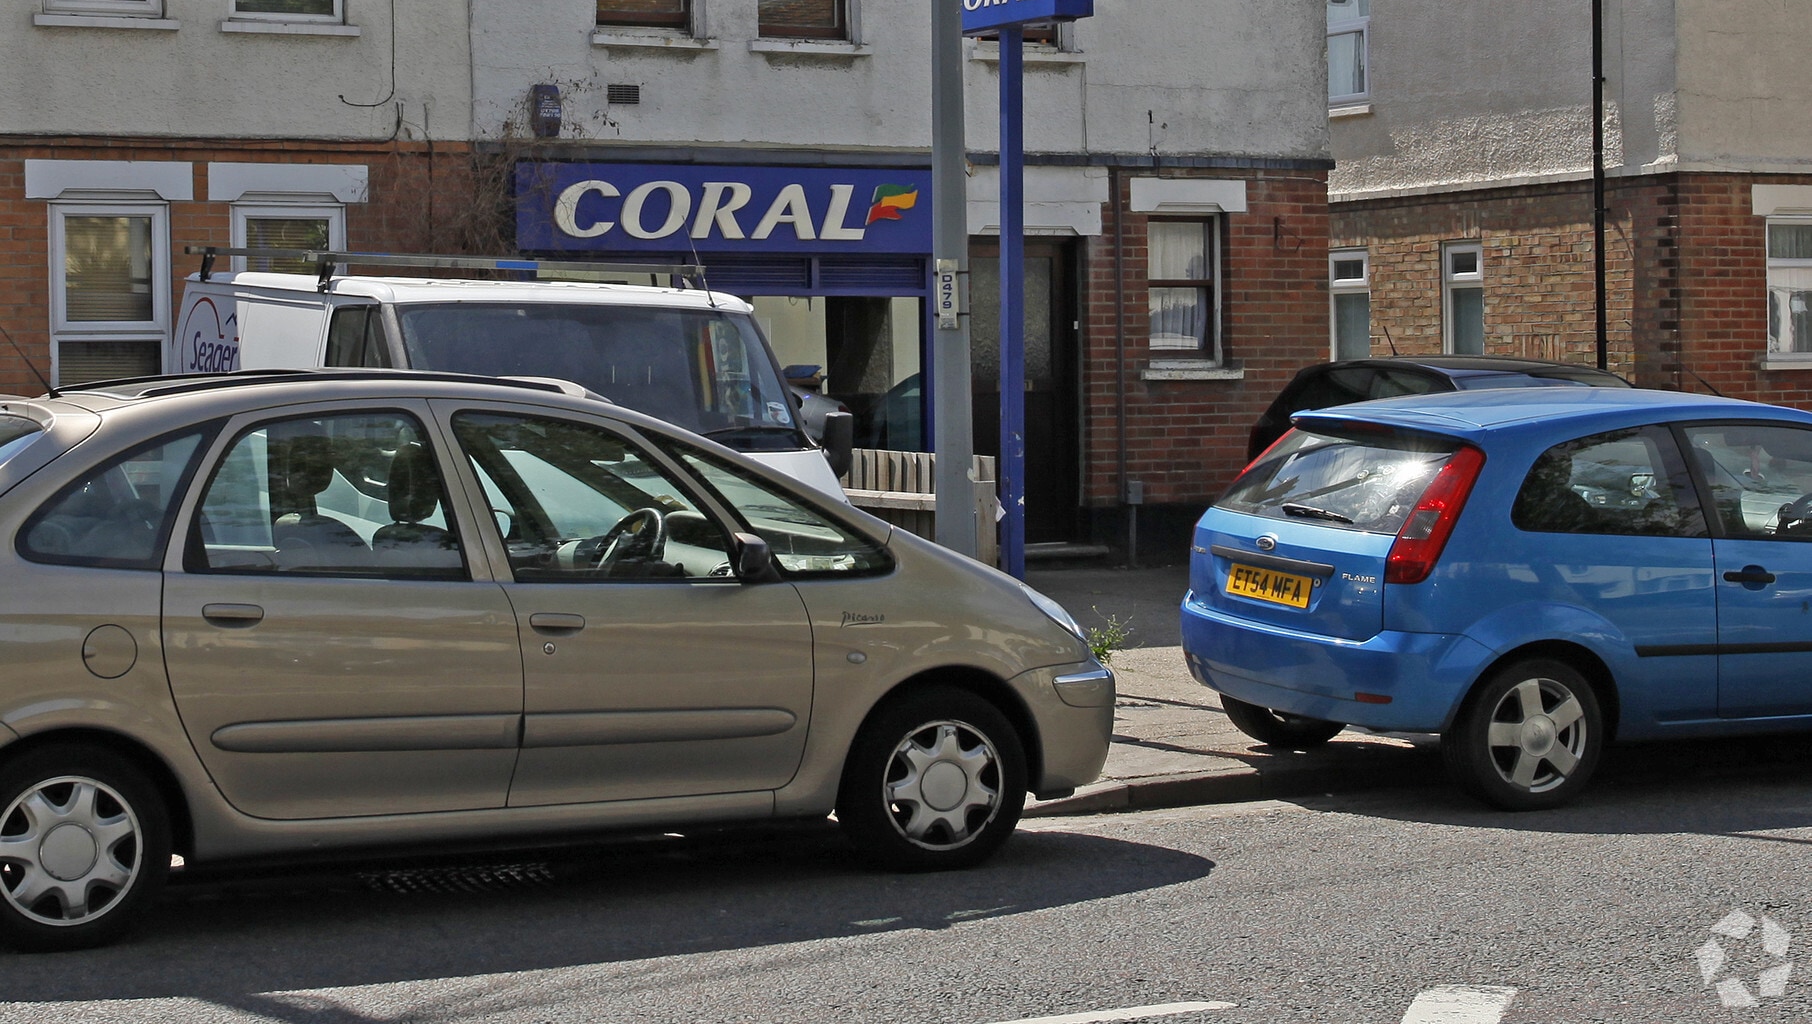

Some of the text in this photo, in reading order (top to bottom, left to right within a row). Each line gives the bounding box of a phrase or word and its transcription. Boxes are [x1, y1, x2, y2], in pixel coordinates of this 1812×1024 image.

[554, 179, 866, 240] CORAL
[941, 274, 953, 309] D479
[1232, 567, 1302, 602] ET54 MFA
[1341, 572, 1376, 584] FLAME
